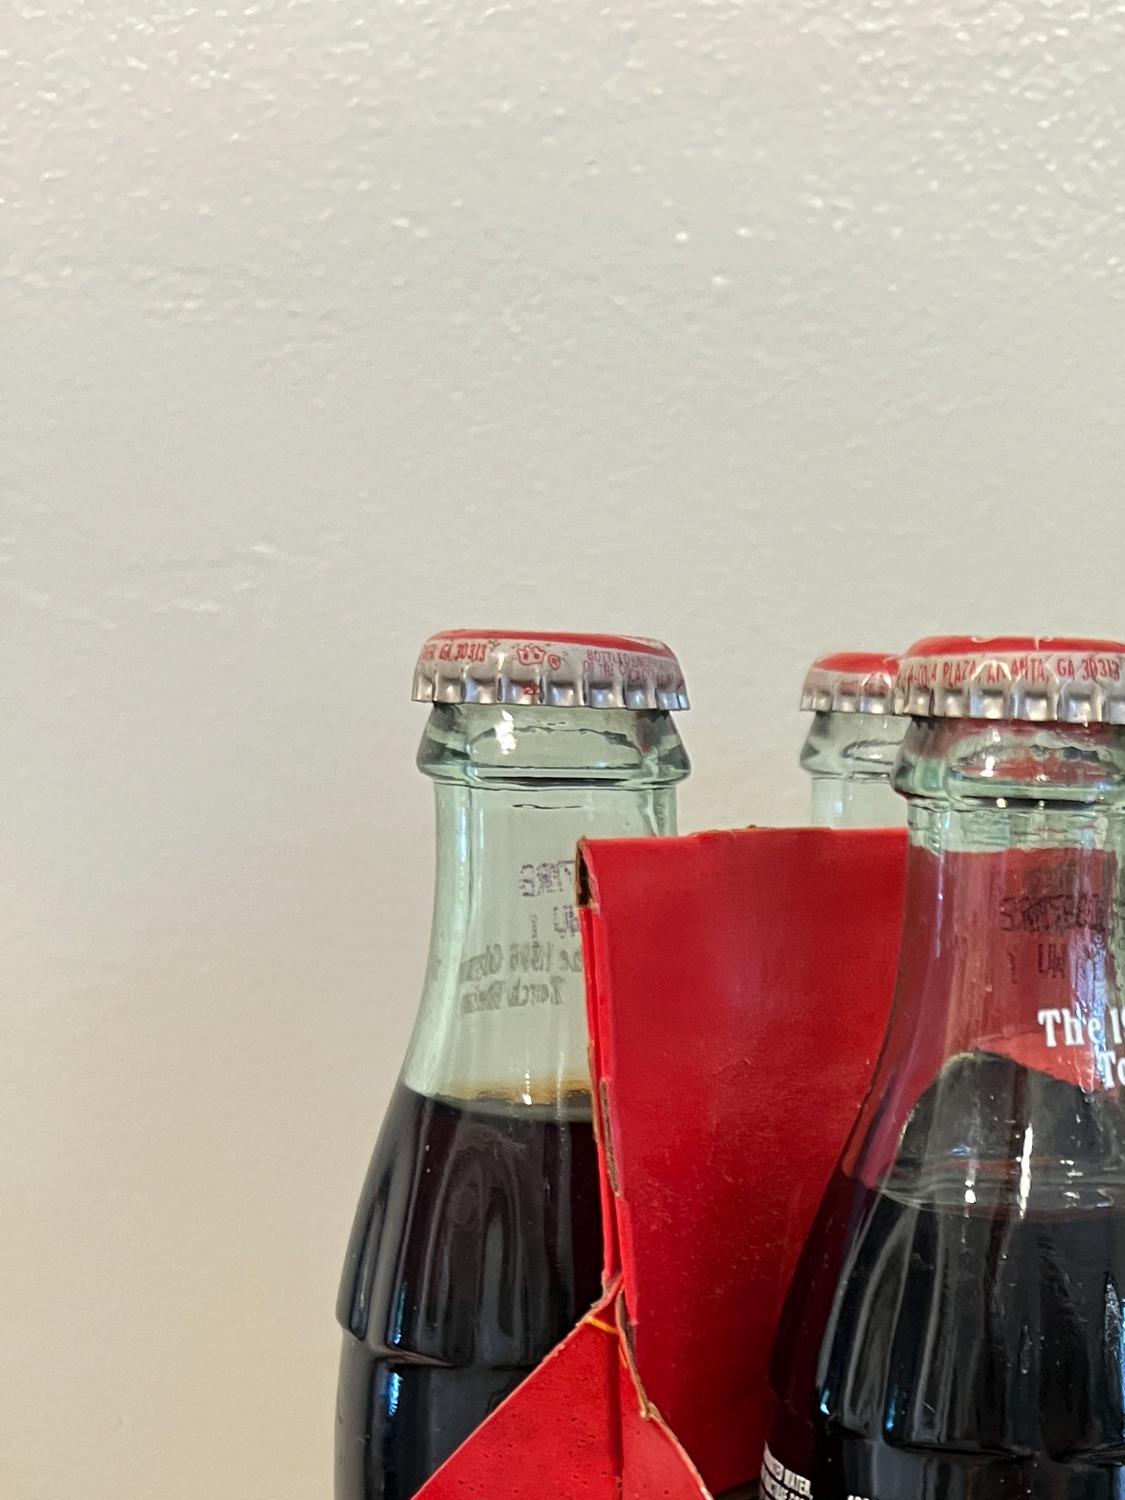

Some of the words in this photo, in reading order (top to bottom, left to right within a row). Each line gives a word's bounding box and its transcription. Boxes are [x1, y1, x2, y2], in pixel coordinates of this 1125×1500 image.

[1056, 657, 1076, 681] GA
[1082, 656, 1121, 682] 30313
[1037, 1008, 1103, 1048] The
